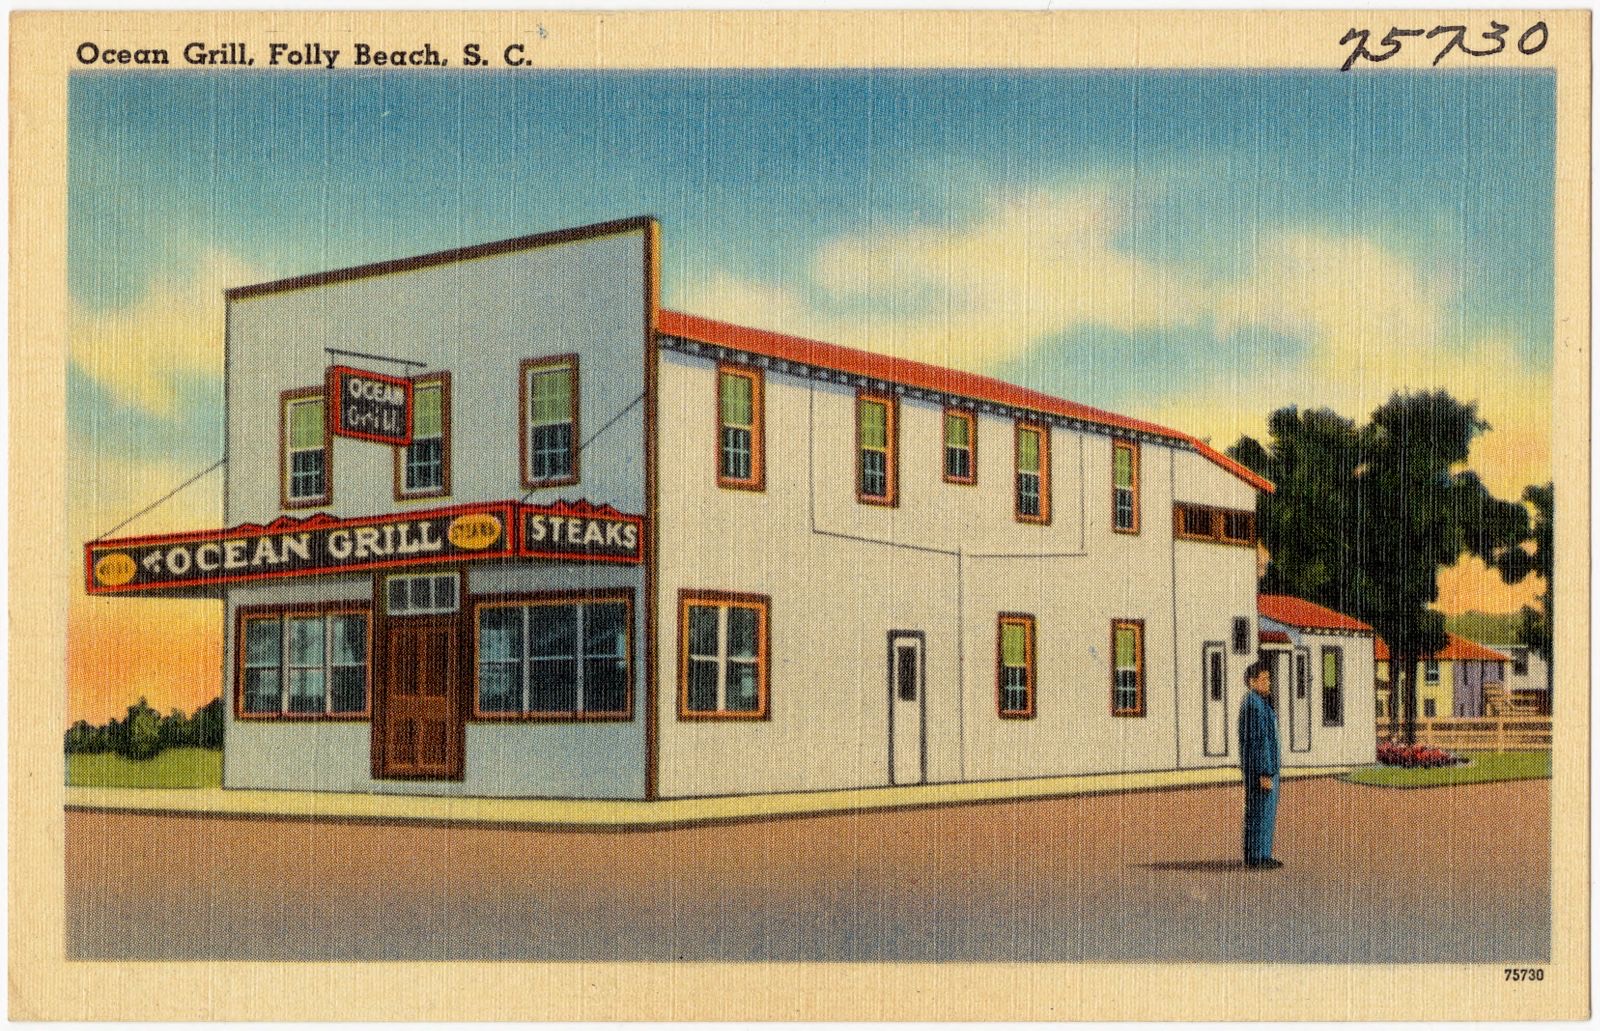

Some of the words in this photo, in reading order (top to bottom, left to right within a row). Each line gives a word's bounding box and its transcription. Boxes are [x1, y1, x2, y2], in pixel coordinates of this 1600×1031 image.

[1339, 21, 1549, 72] 75730
[349, 377, 405, 406] OCEAN
[165, 533, 311, 574] OCEAN
[328, 521, 442, 560] GRILL
[531, 515, 638, 549] STEAKS
